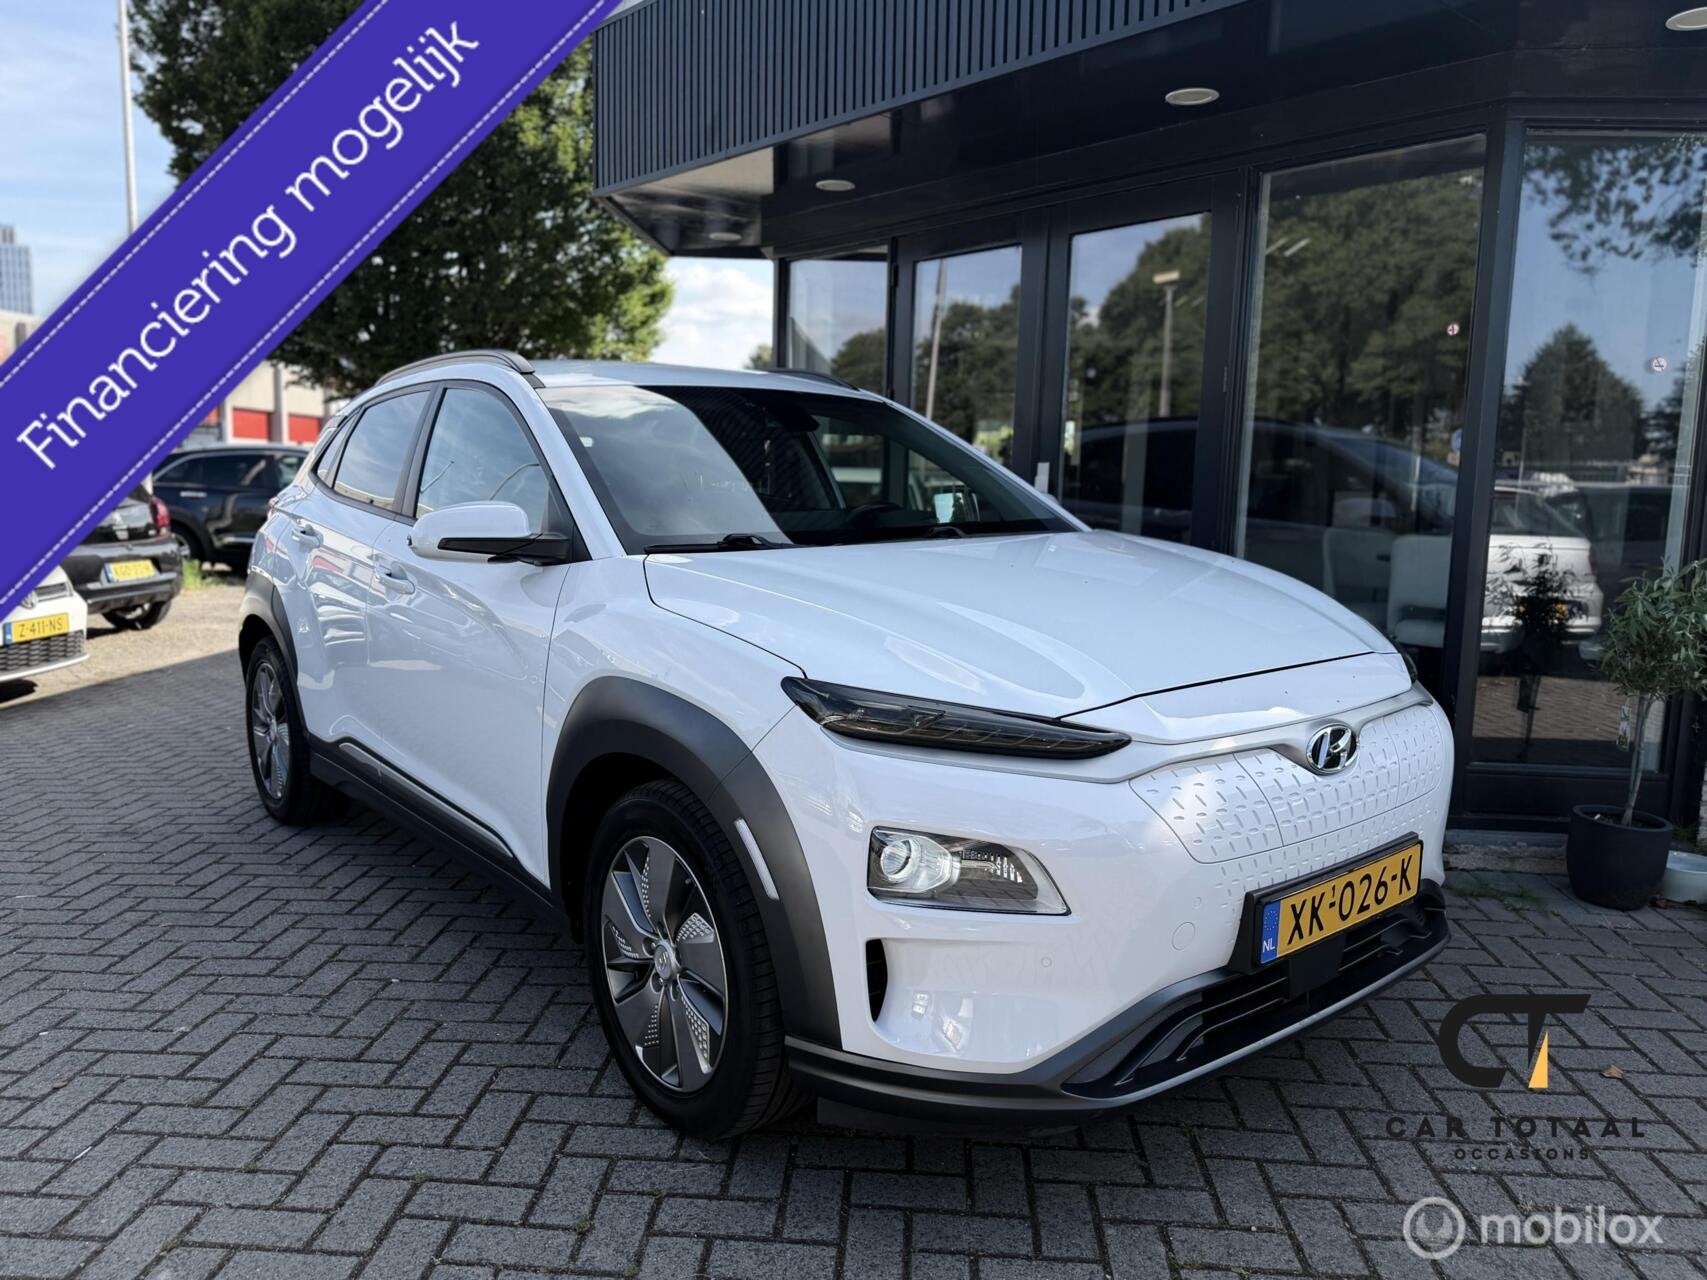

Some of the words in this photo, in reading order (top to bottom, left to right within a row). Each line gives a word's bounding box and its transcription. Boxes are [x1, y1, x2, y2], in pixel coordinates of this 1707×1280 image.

[19, 616, 64, 638] Z-411-NS
[1286, 854, 1413, 946] XK-026-K
[1262, 938, 1276, 953] NL
